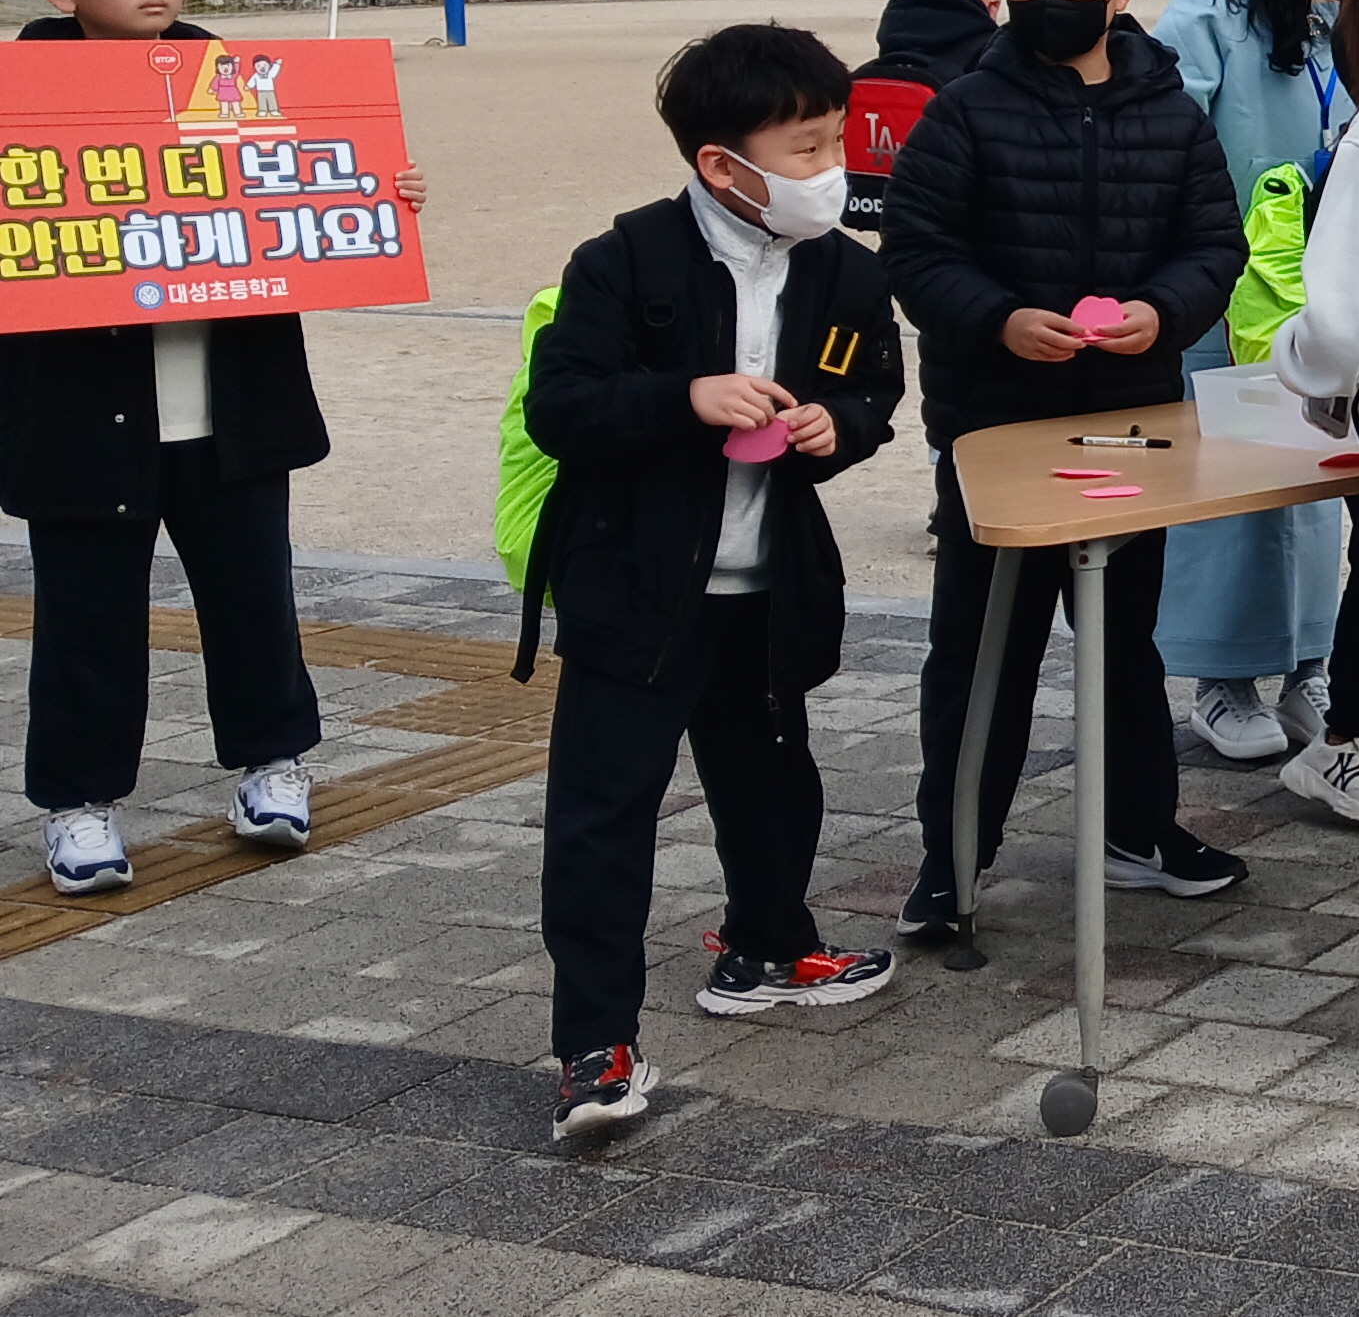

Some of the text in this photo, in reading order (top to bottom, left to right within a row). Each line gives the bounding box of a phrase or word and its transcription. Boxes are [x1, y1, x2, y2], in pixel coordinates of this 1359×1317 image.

[0, 140, 380, 208] 한 번 더 보고,
[257, 201, 402, 263] 가요!
[167, 277, 290, 304] 대성초등학교
